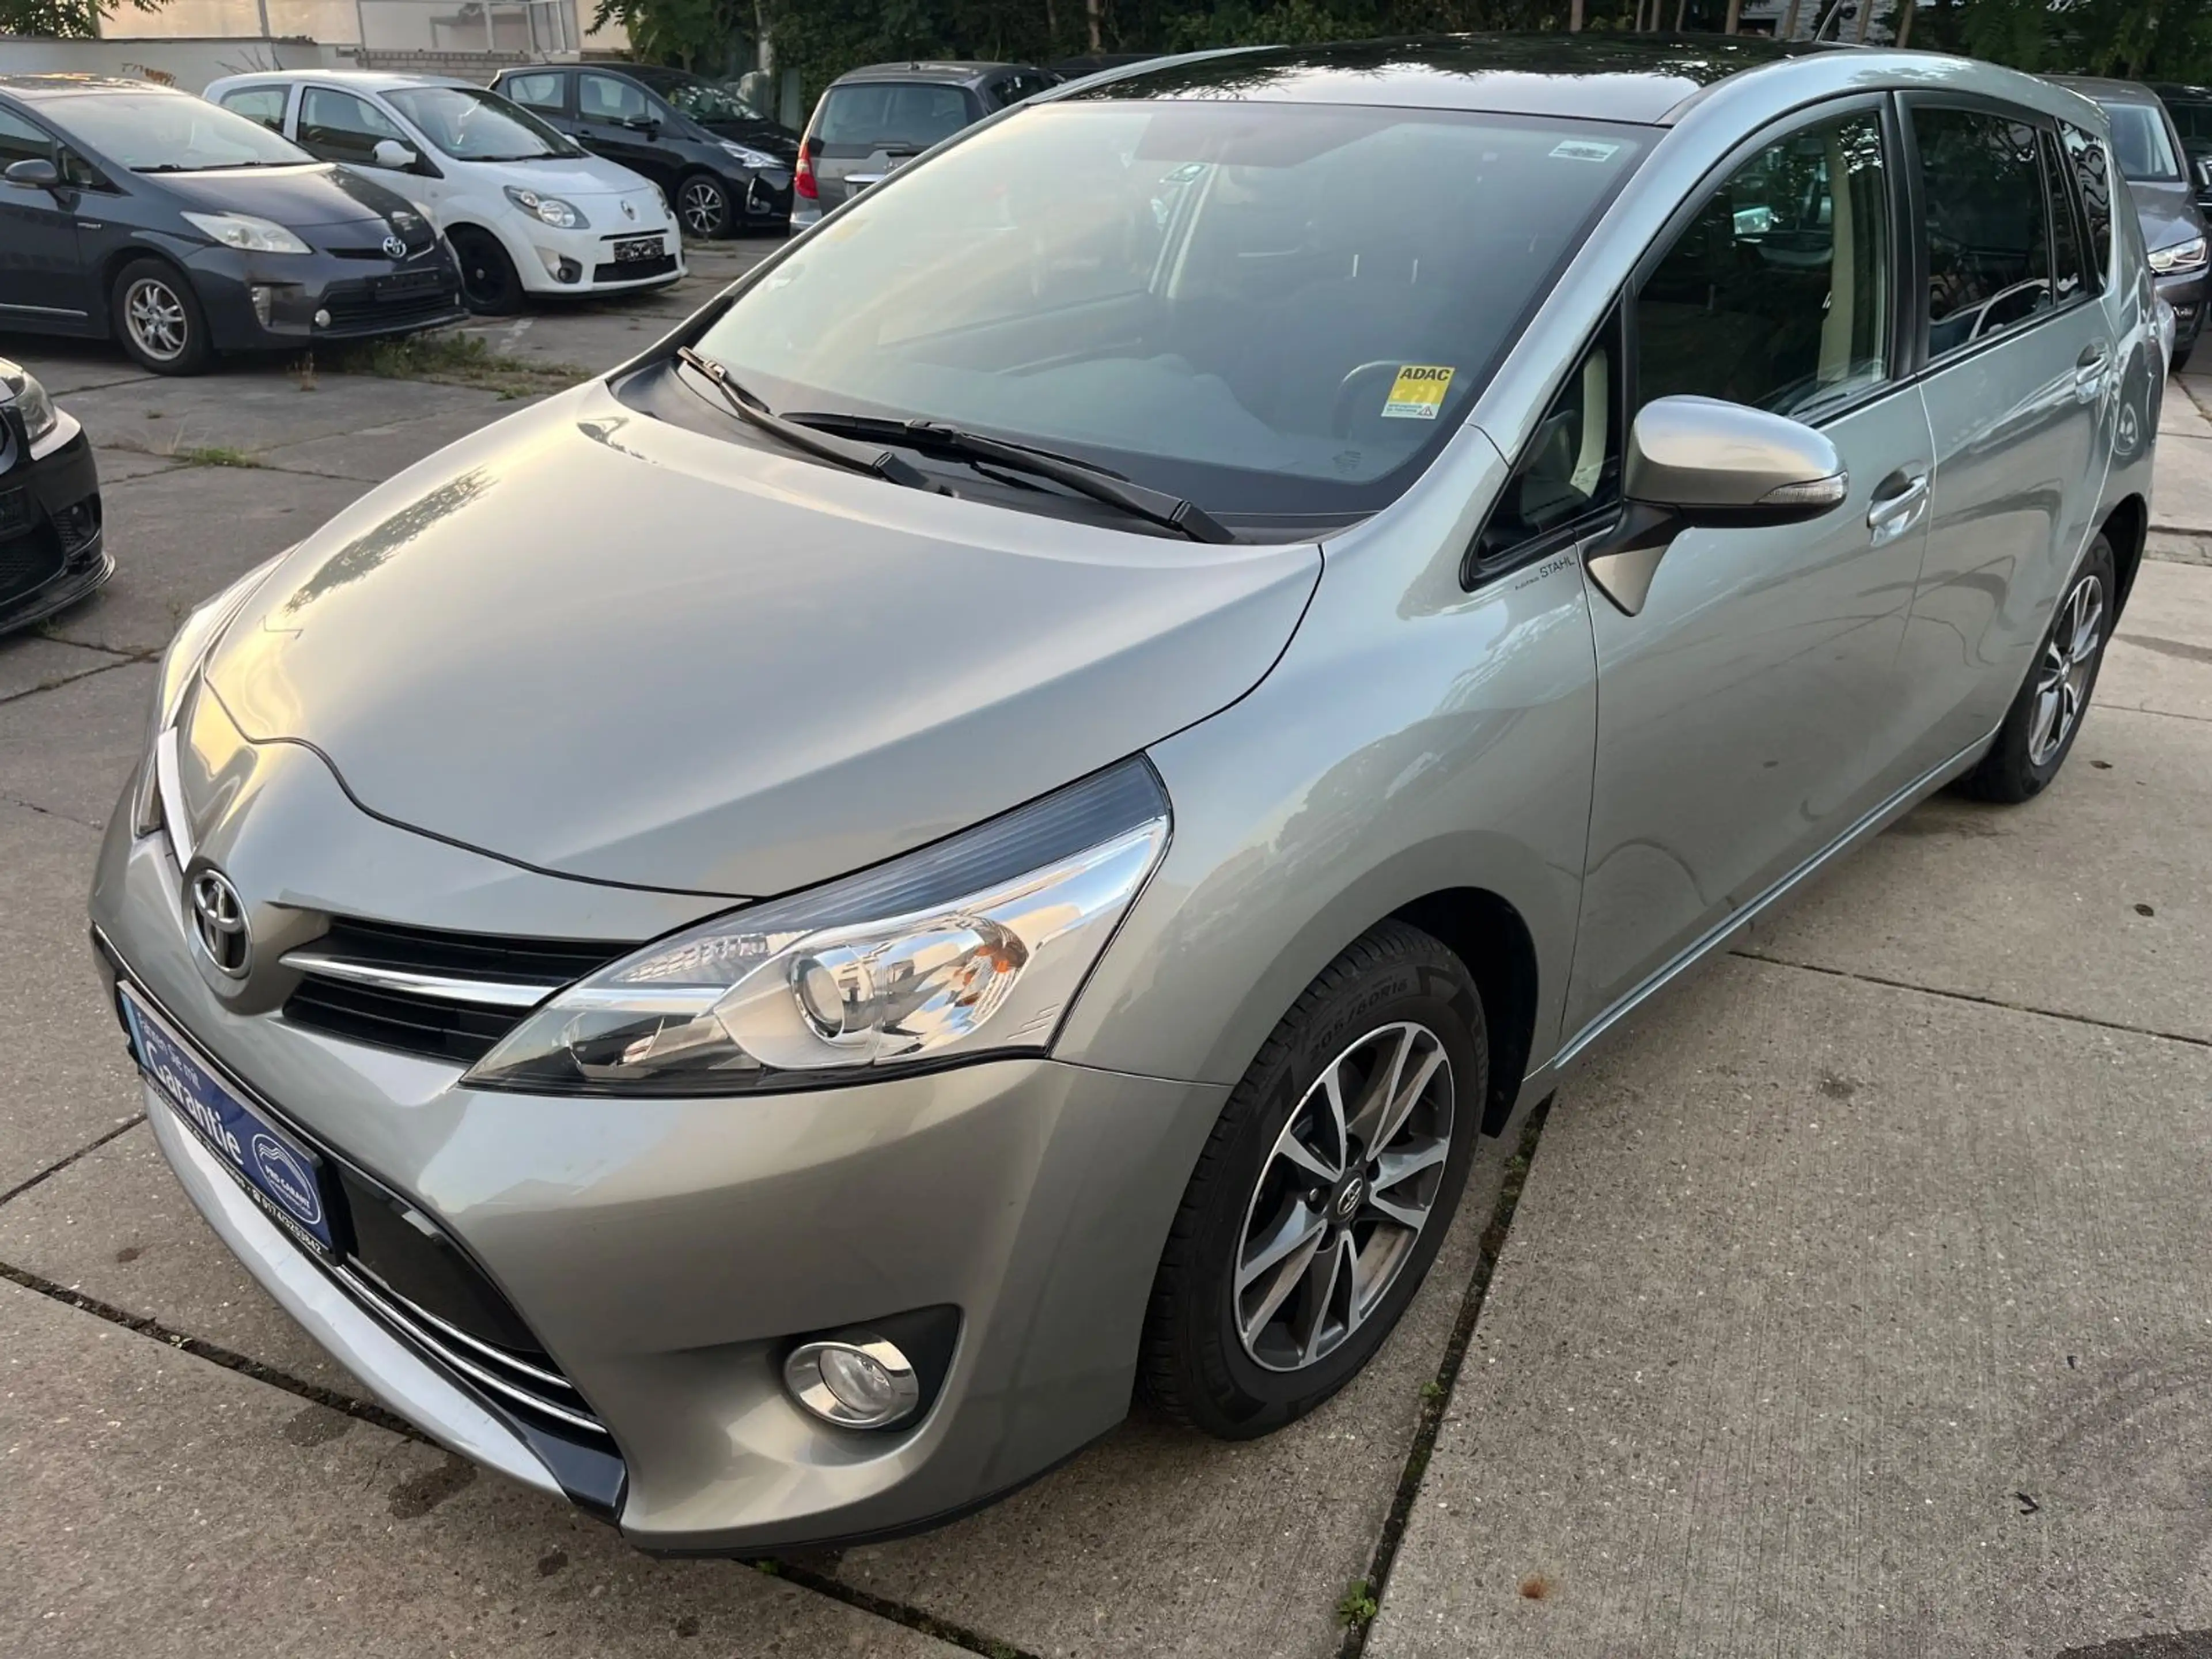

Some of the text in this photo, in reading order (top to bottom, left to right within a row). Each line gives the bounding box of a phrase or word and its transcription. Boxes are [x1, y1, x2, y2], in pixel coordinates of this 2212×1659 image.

[1400, 368, 1450, 381] ADAC
[1540, 556, 1575, 578] STAHL
[146, 1040, 244, 1166] Garantie
